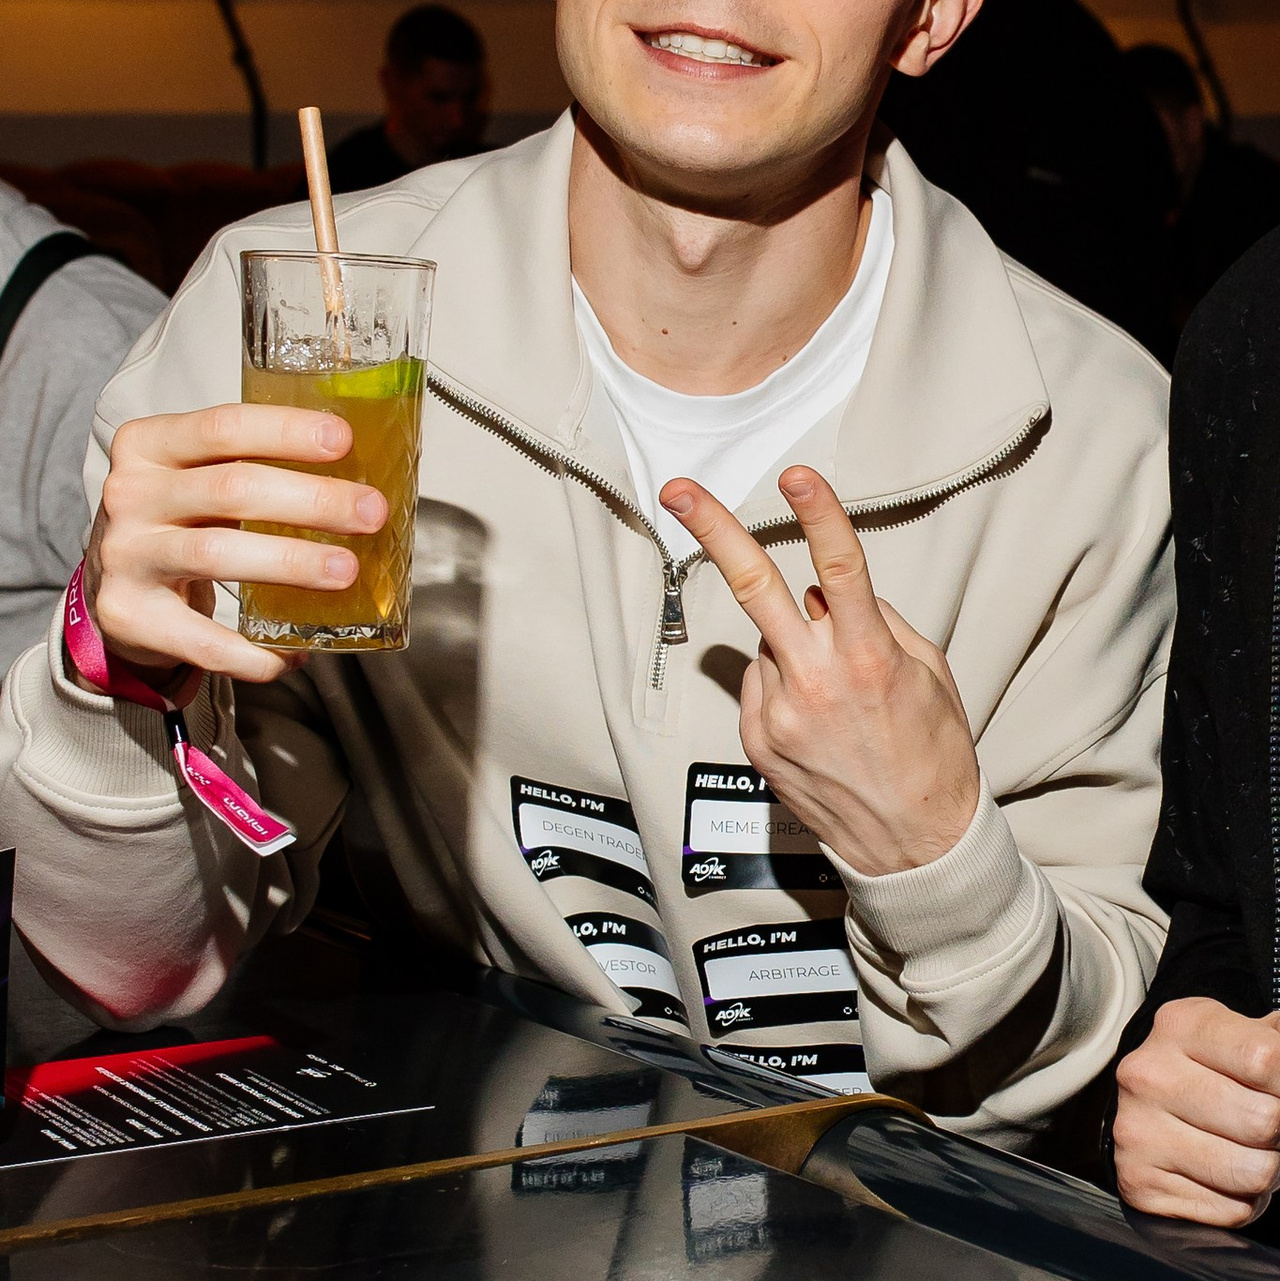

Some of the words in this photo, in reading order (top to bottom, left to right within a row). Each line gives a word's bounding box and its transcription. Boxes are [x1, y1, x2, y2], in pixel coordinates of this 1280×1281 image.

[695, 774, 754, 793] HELLO,
[520, 784, 577, 808] HELLO,
[580, 798, 605, 813] I'M
[542, 820, 595, 841] DEGEN
[710, 820, 760, 834] MEME
[765, 821, 812, 836] CREA
[602, 921, 626, 935] I'M
[703, 933, 766, 953] HELLO,
[770, 931, 797, 944] I'M
[600, 959, 657, 975] VESTOR
[749, 964, 841, 982] ARBITRAGE
[791, 1054, 818, 1067] I'M
